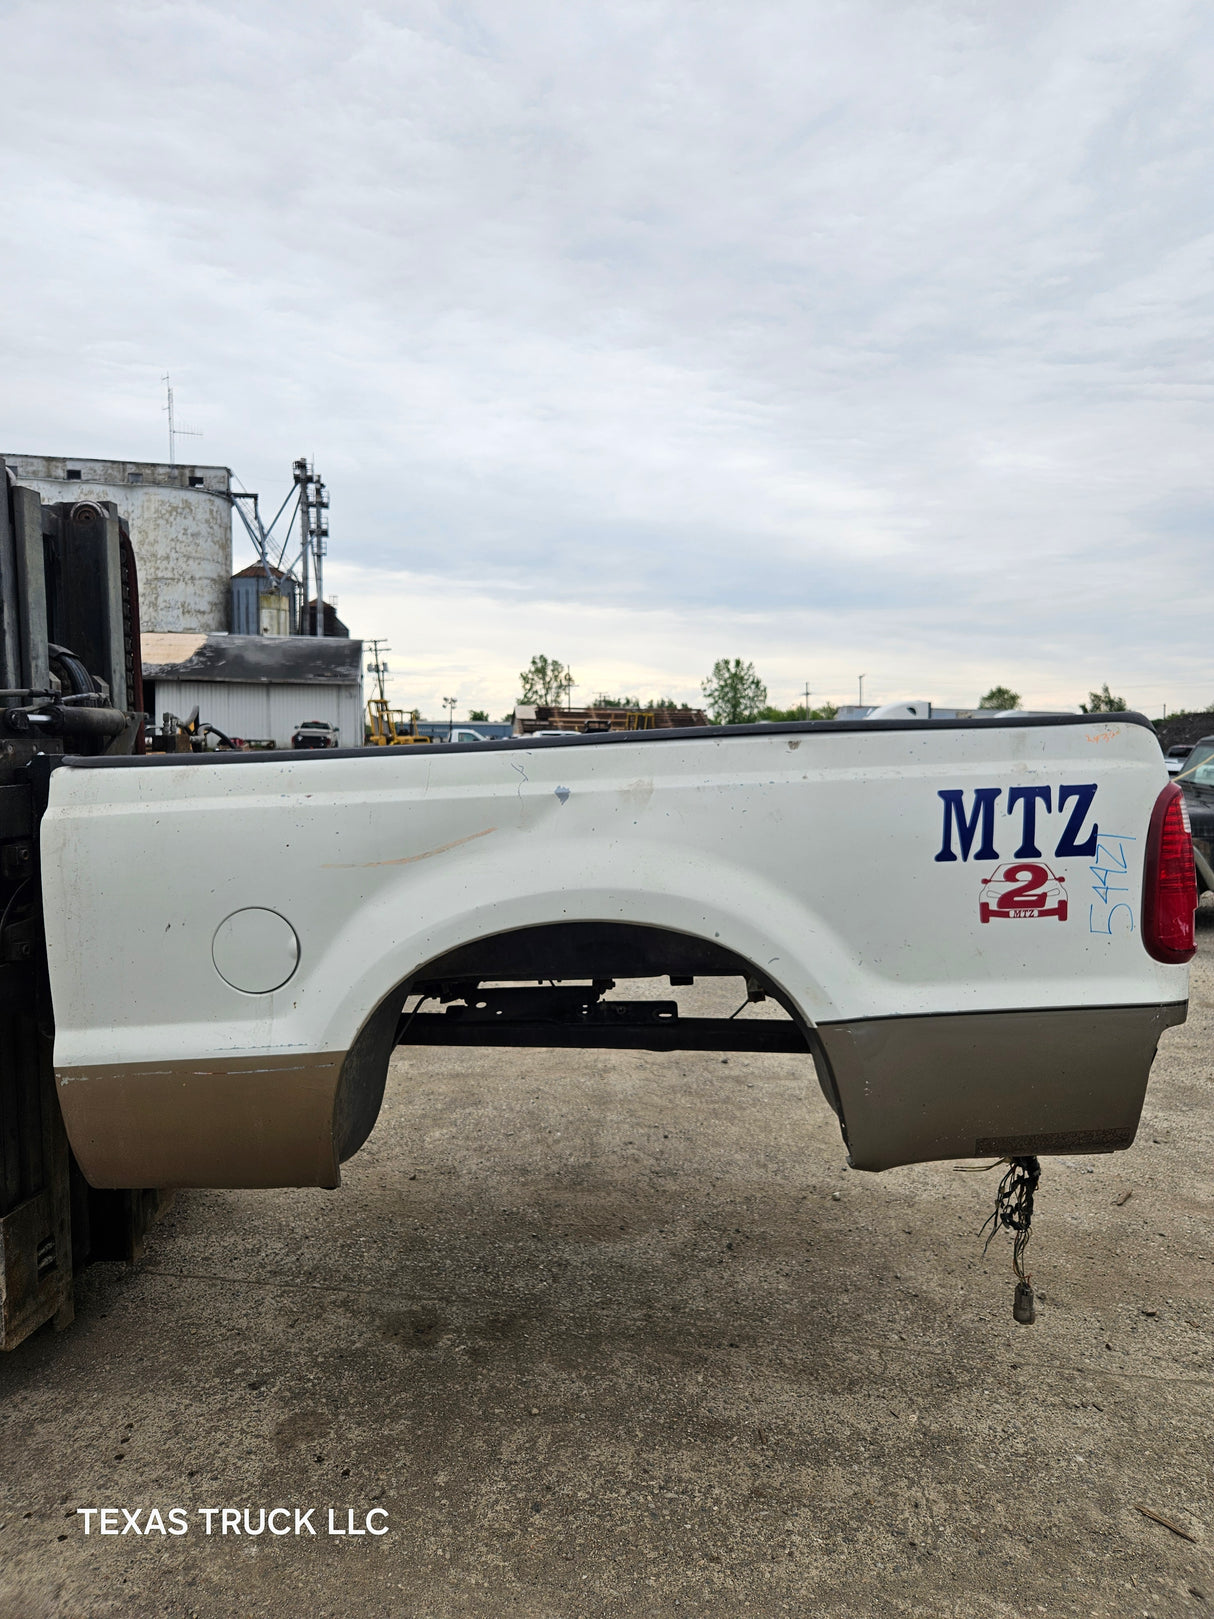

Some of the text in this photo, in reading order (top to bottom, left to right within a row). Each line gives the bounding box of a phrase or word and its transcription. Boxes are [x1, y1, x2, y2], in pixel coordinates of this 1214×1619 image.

[934, 783, 1098, 862] MTZ
[996, 863, 1048, 909] 2
[1013, 909, 1036, 918] MTZ
